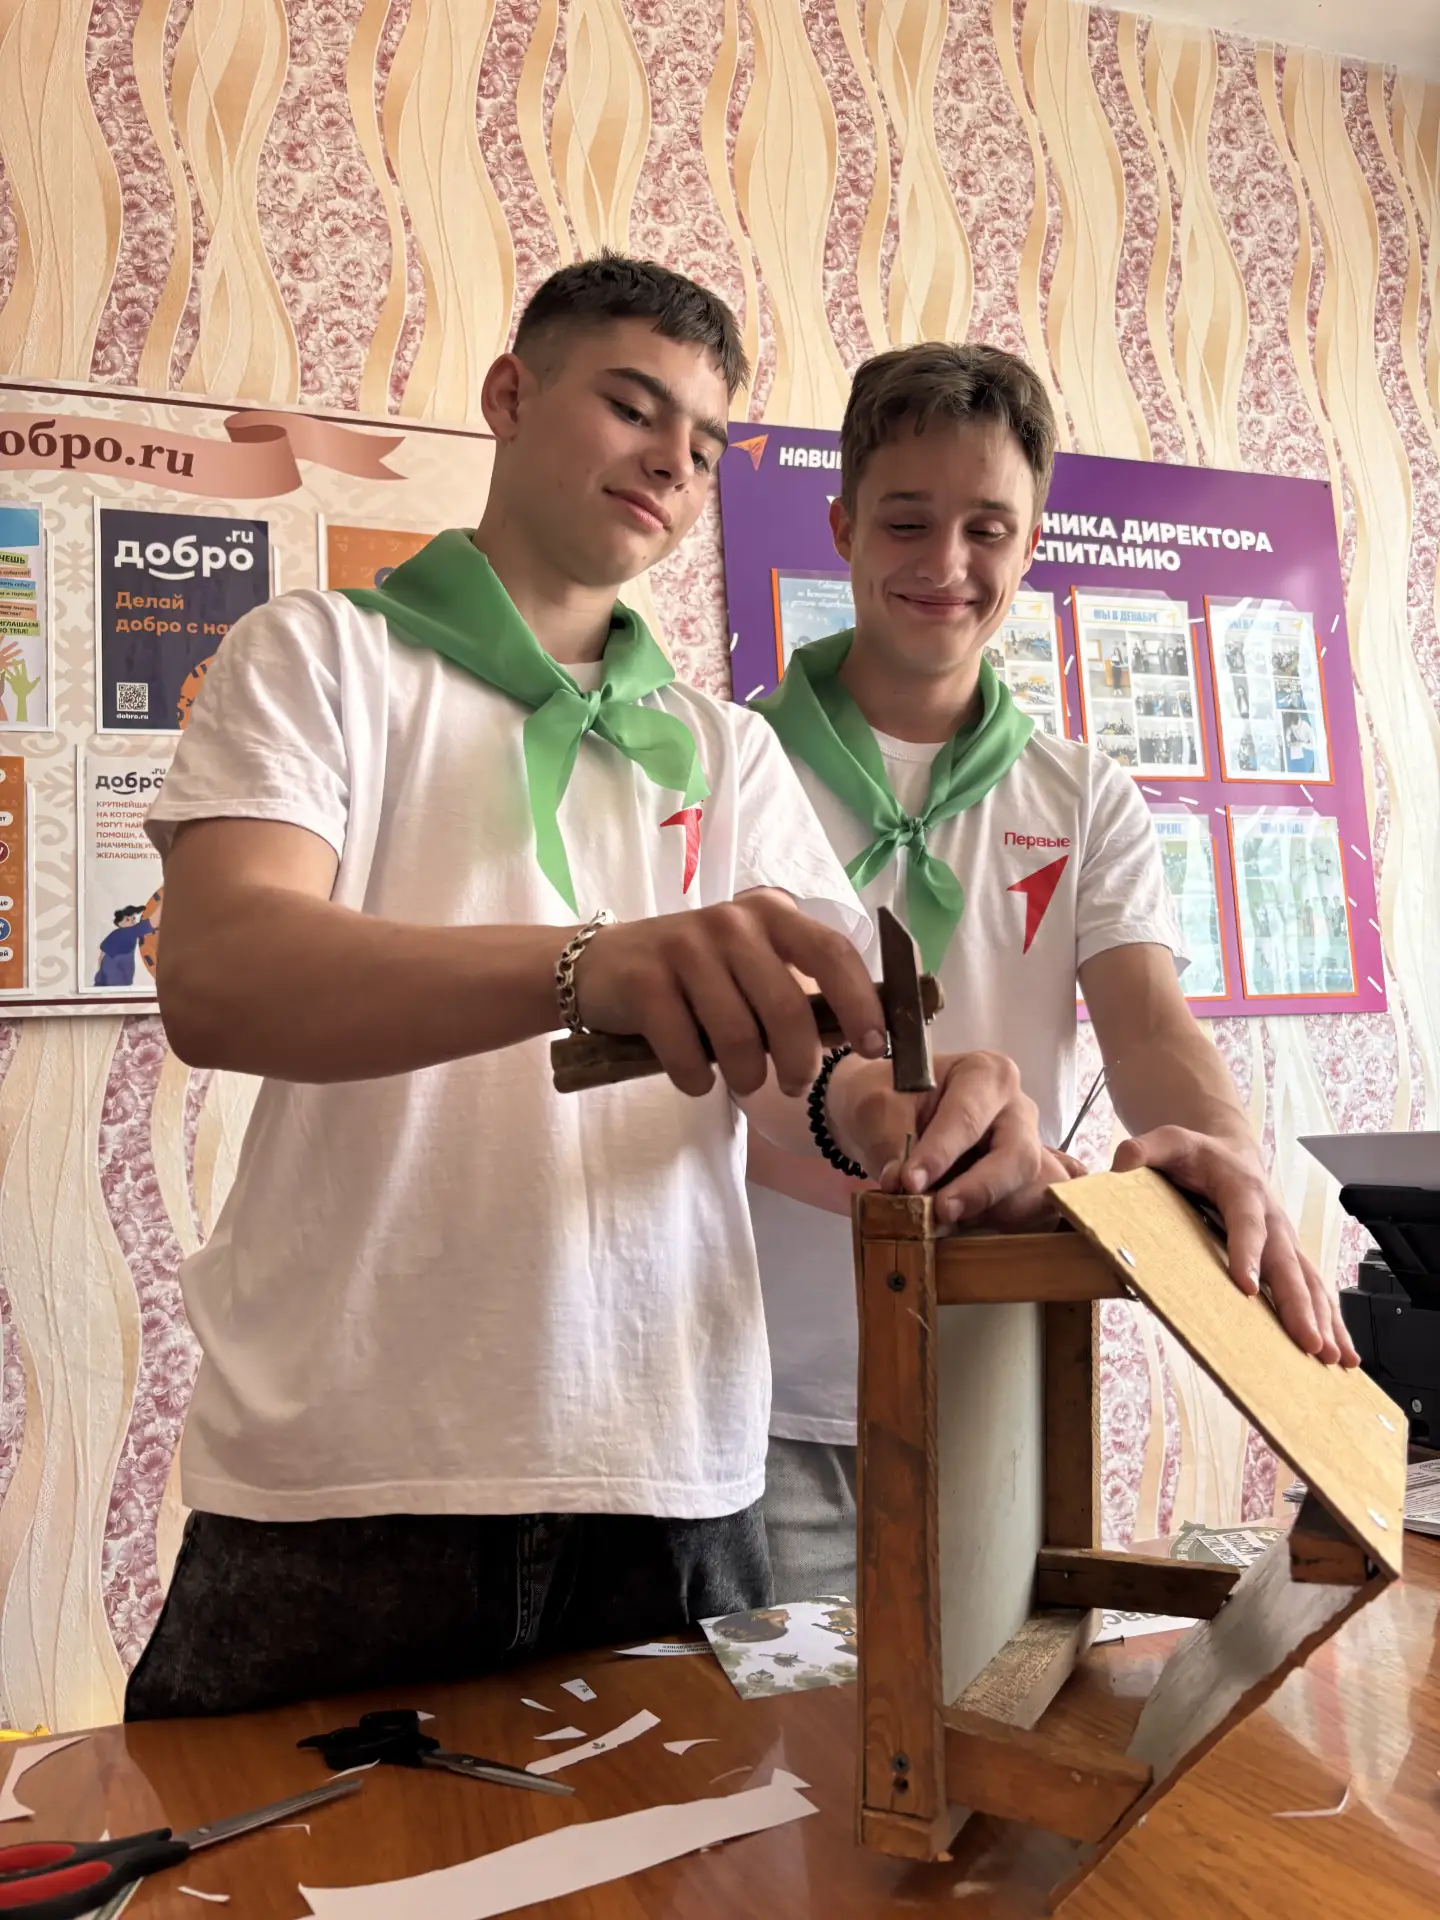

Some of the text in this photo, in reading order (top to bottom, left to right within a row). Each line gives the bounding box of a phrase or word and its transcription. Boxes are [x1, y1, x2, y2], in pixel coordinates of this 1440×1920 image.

[1042, 512, 1273, 552] НИКА ДИРЕКТОРА
[114, 535, 254, 579] добро
[116, 591, 184, 609] Делай
[116, 616, 232, 636] добро с на
[95, 771, 164, 794] добро
[96, 800, 152, 809] КРУПНЕЙША
[1004, 832, 1070, 849] Первые
